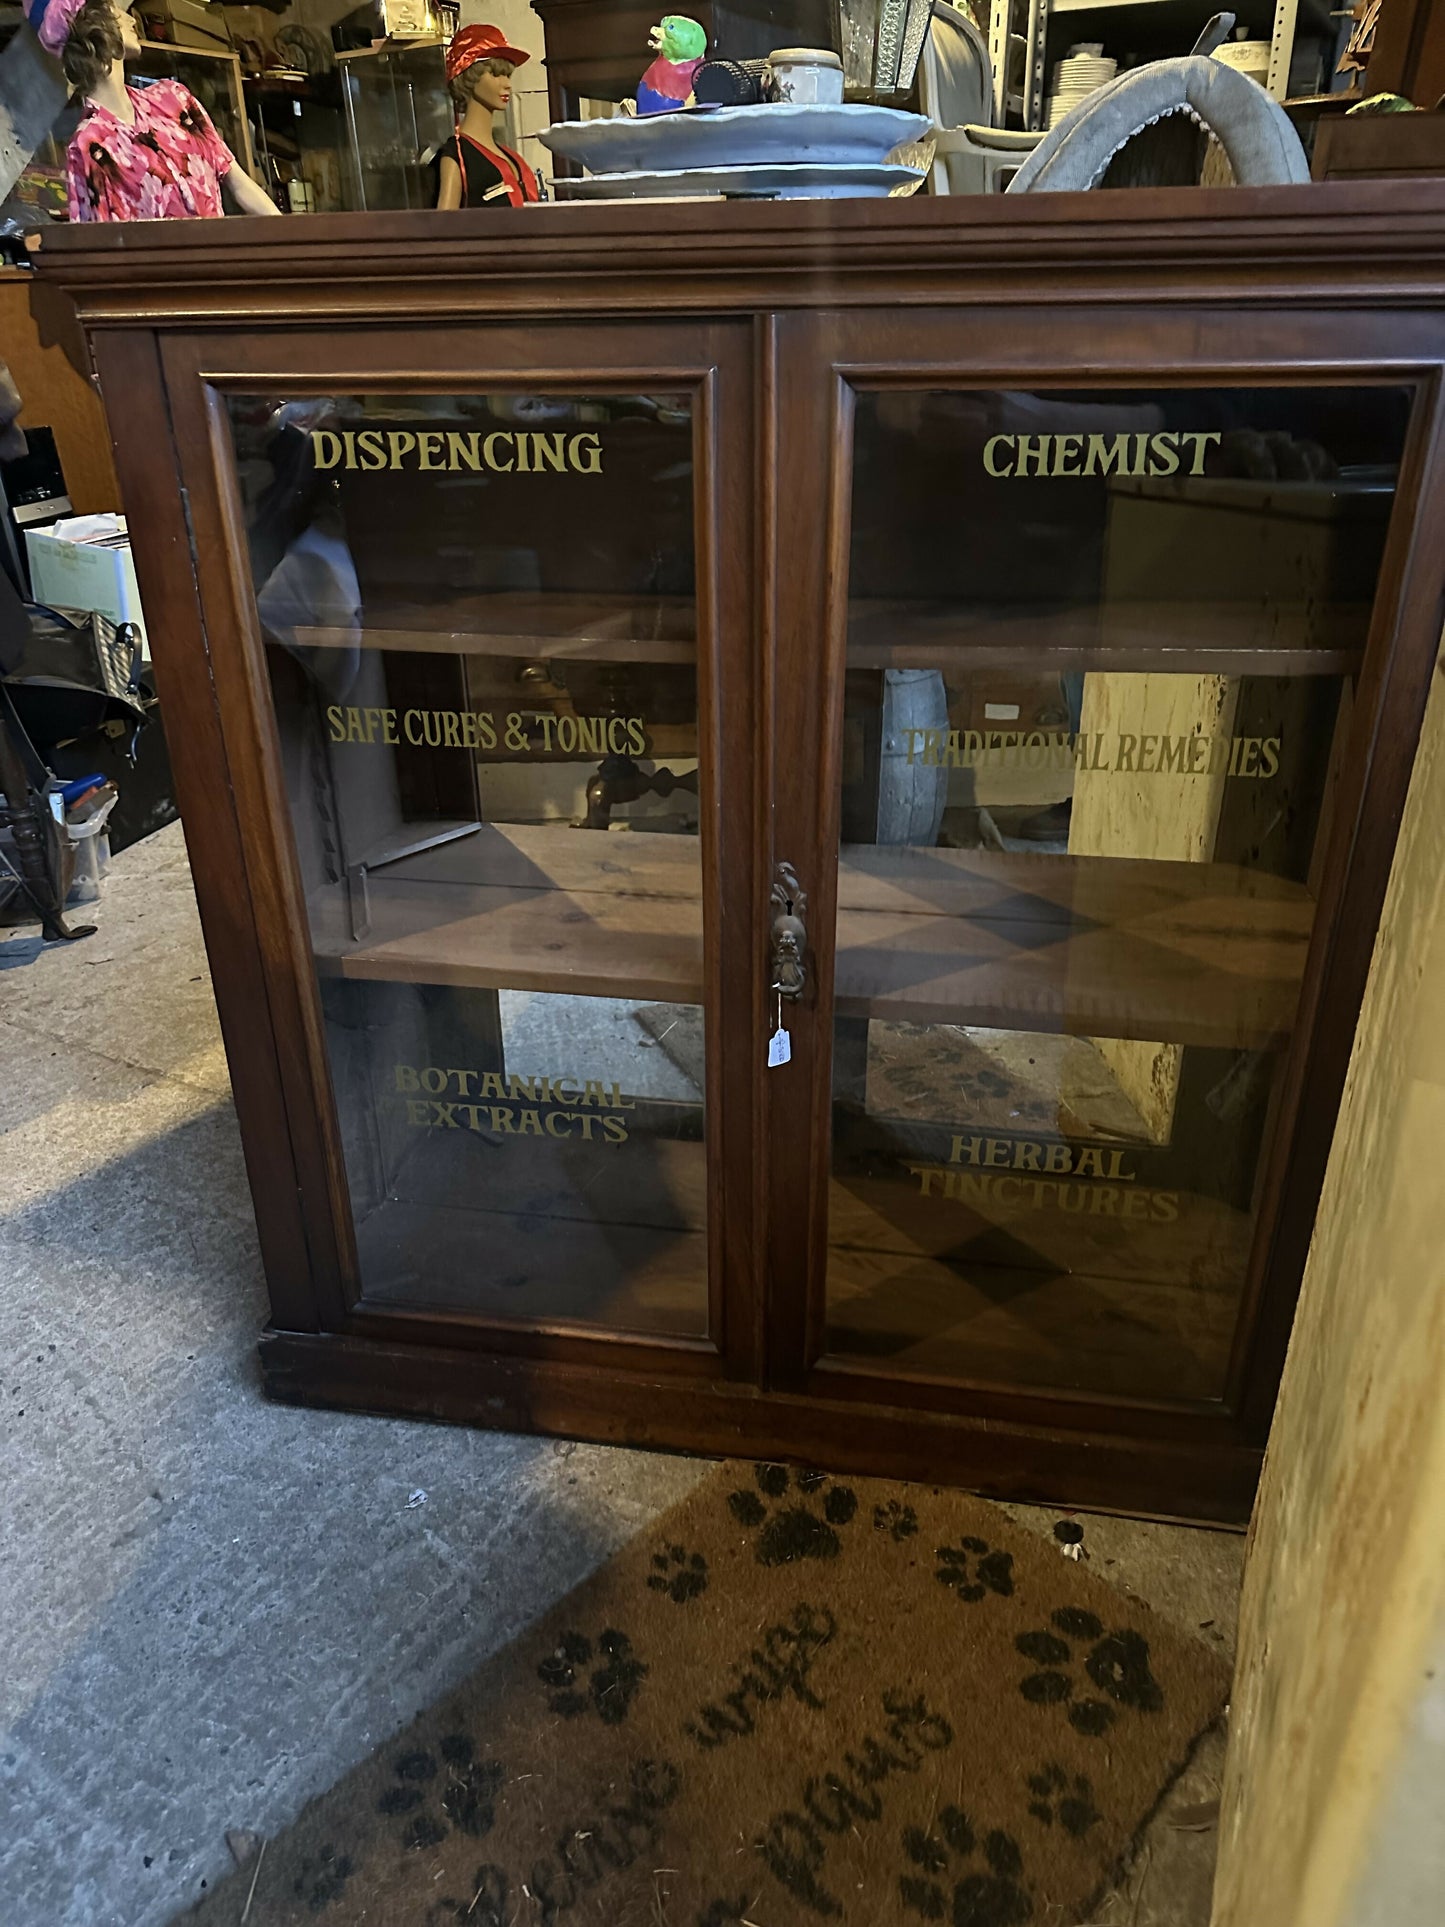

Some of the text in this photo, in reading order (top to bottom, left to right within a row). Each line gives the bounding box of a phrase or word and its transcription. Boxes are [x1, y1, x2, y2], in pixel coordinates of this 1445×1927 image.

[311, 430, 603, 474] DISPENCING
[983, 432, 1221, 477] CHEMIST
[327, 705, 646, 756] SAFE CURES & TONICS
[902, 728, 1281, 779] TRADITIONAL REMEDIES
[393, 1064, 636, 1110] BOTANICAL
[406, 1100, 629, 1144] EXTRACTS
[949, 1135, 1136, 1181] HERBAL
[909, 1166, 1179, 1223] TINCTURES
[681, 1602, 836, 1749] wipe
[753, 1688, 953, 1920] paws
